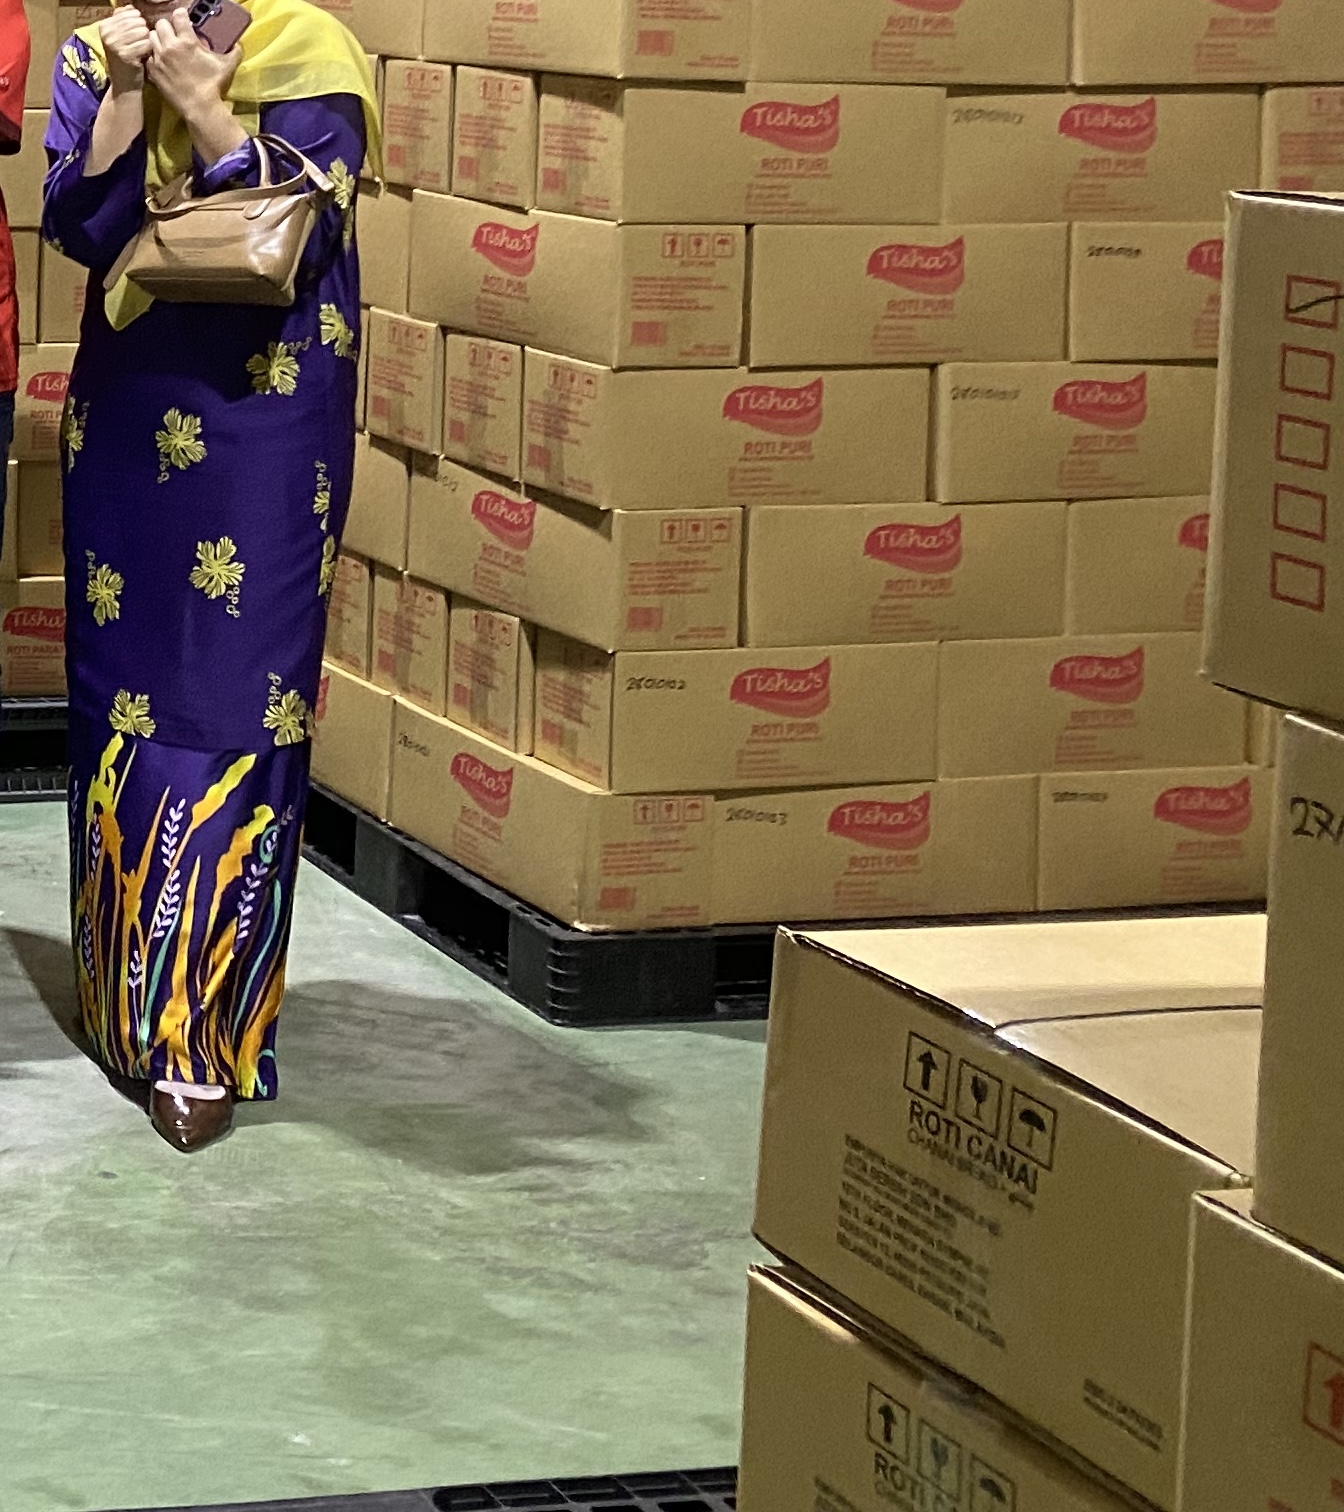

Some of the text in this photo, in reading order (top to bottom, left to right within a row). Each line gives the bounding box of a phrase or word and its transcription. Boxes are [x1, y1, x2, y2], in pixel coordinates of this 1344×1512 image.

[752, 105, 834, 128] Tisha's
[878, 249, 959, 270] Tisha's
[734, 387, 818, 412] Tisha's
[741, 671, 824, 694] Tisha's
[839, 804, 923, 826] Tisha's
[908, 1099, 961, 1149] ROTI
